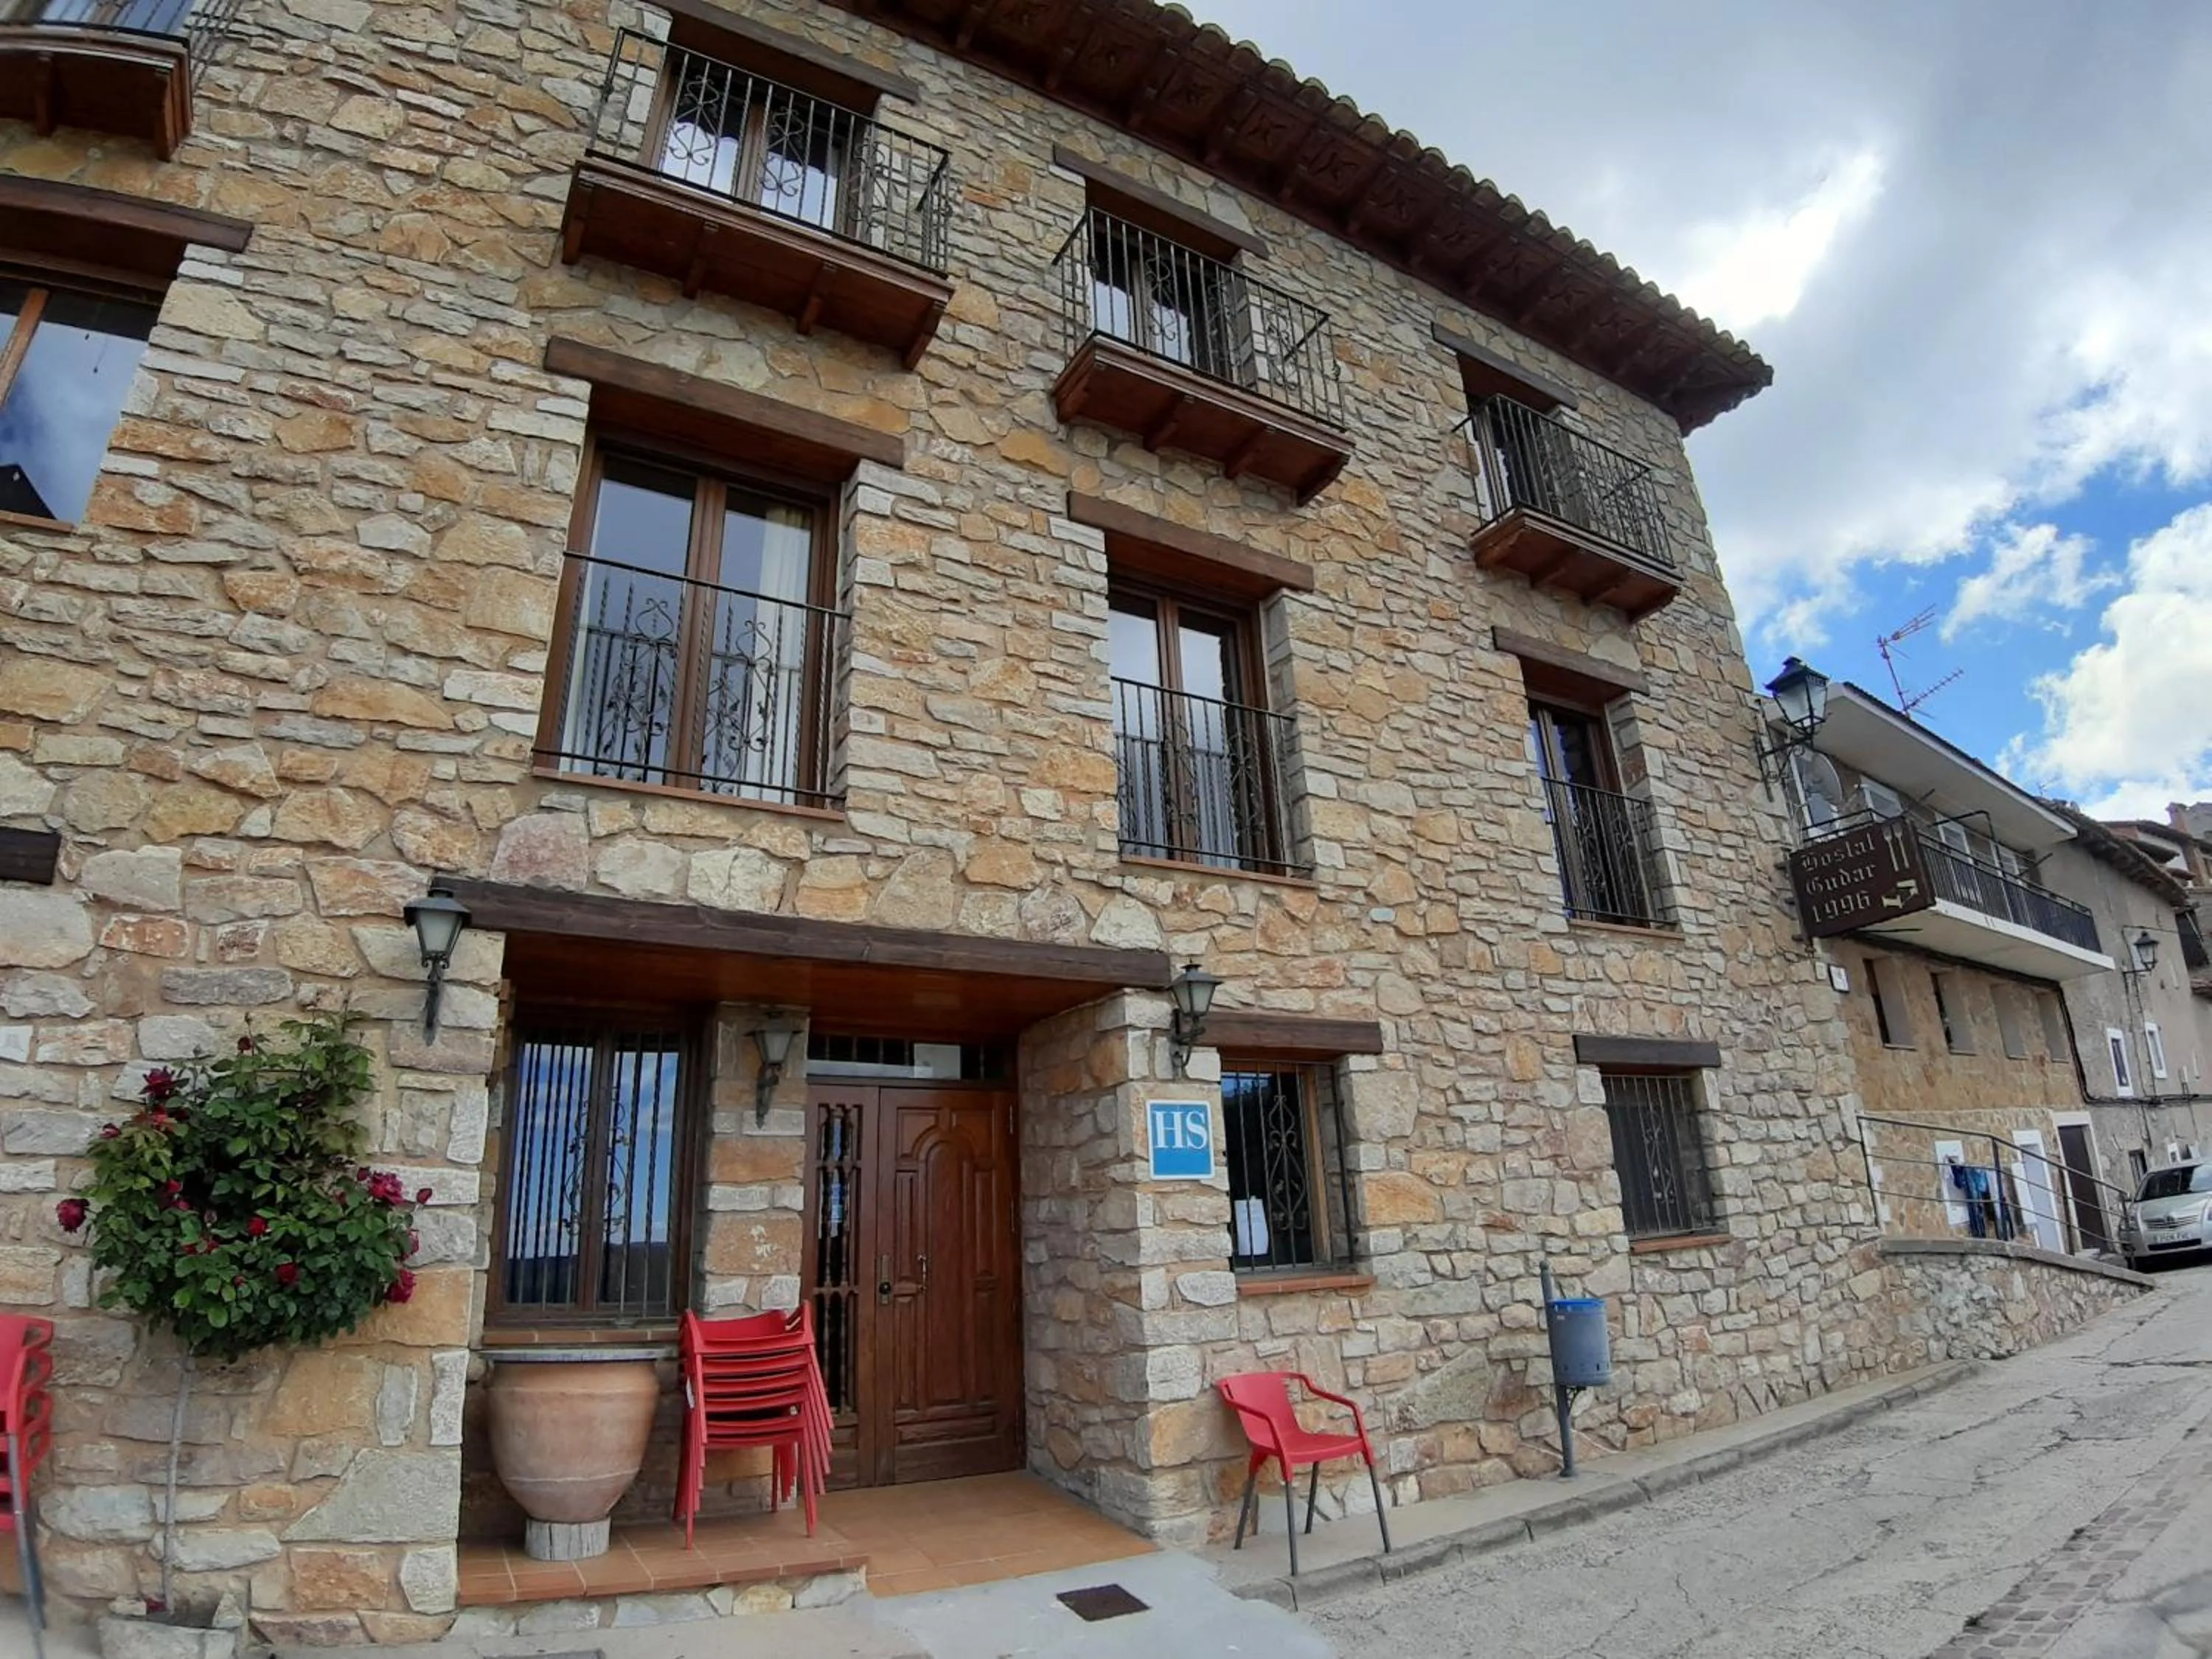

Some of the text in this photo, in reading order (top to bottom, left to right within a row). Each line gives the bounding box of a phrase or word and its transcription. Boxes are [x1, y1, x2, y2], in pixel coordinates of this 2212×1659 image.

[1801, 832, 1875, 872] Hostal
[1812, 890, 1871, 922] 1996
[1152, 1110, 1207, 1150] HS
